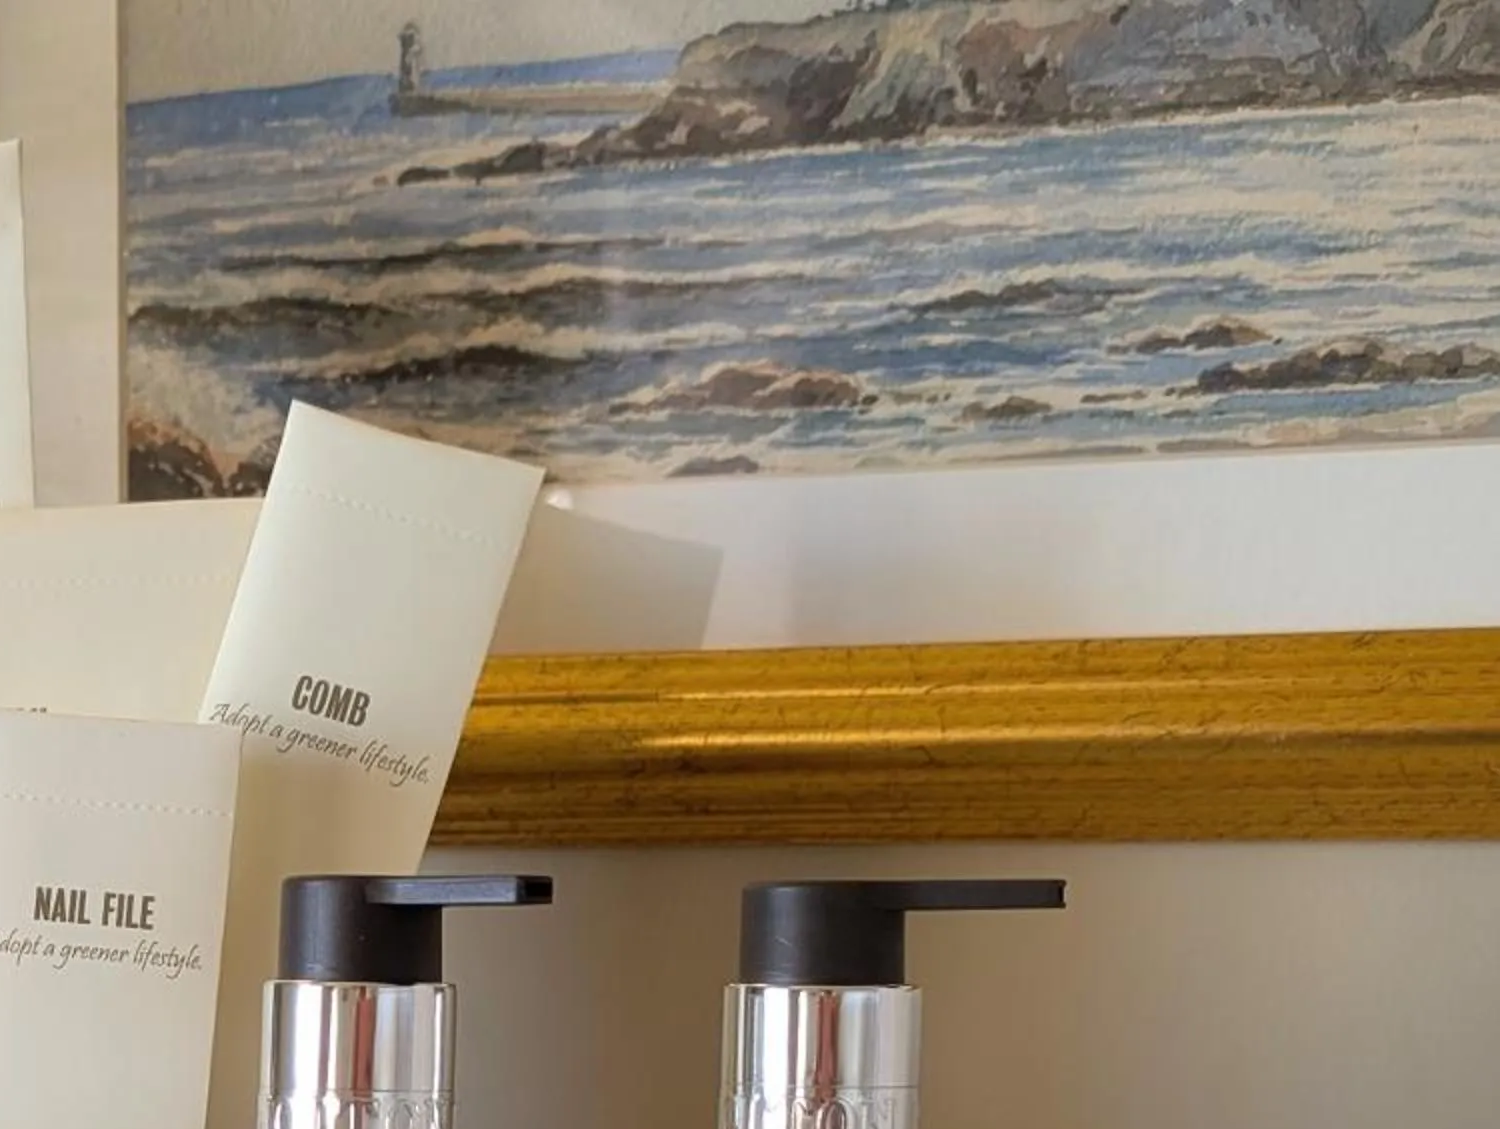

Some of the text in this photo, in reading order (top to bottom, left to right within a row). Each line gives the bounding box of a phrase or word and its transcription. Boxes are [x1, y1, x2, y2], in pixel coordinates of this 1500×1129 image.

[291, 675, 370, 727] COMB
[209, 702, 271, 737] Adopt
[270, 724, 283, 738] a
[276, 727, 357, 759] greener
[34, 886, 156, 930] NAIL FILE
[43, 943, 54, 957] a
[53, 943, 129, 970] greener
